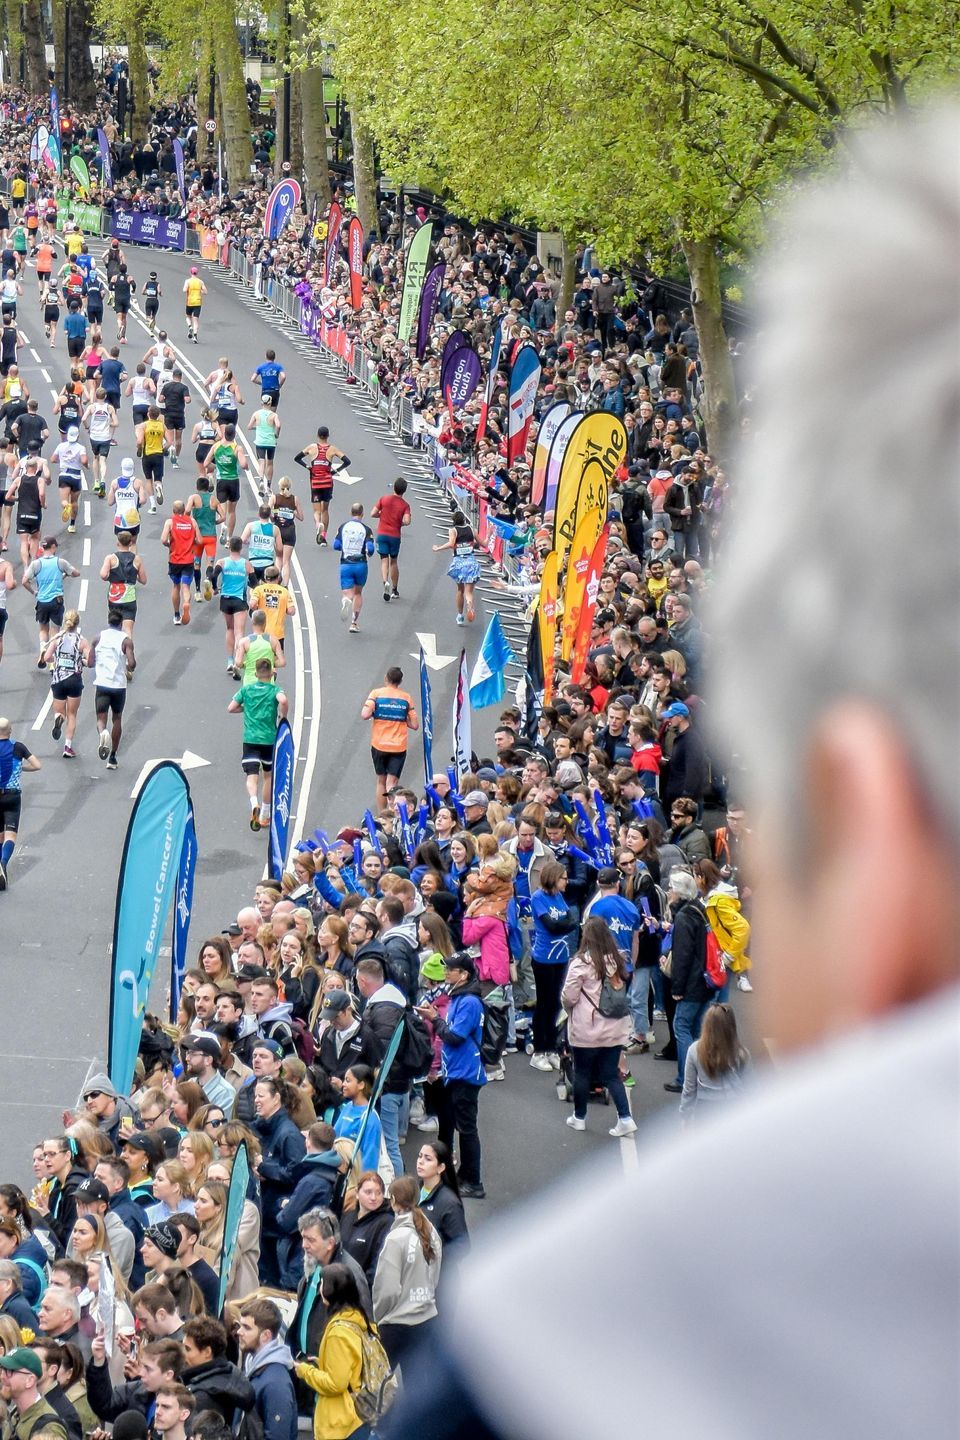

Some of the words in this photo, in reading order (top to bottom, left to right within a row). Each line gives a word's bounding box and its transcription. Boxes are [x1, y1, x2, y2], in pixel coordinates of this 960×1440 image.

[452, 359, 466, 399] London
[457, 371, 472, 401] Youth
[253, 535, 271, 545] Bliss
[164, 810, 175, 831] UK
[156, 835, 173, 892] Cancer
[145, 896, 161, 954] Bowel
